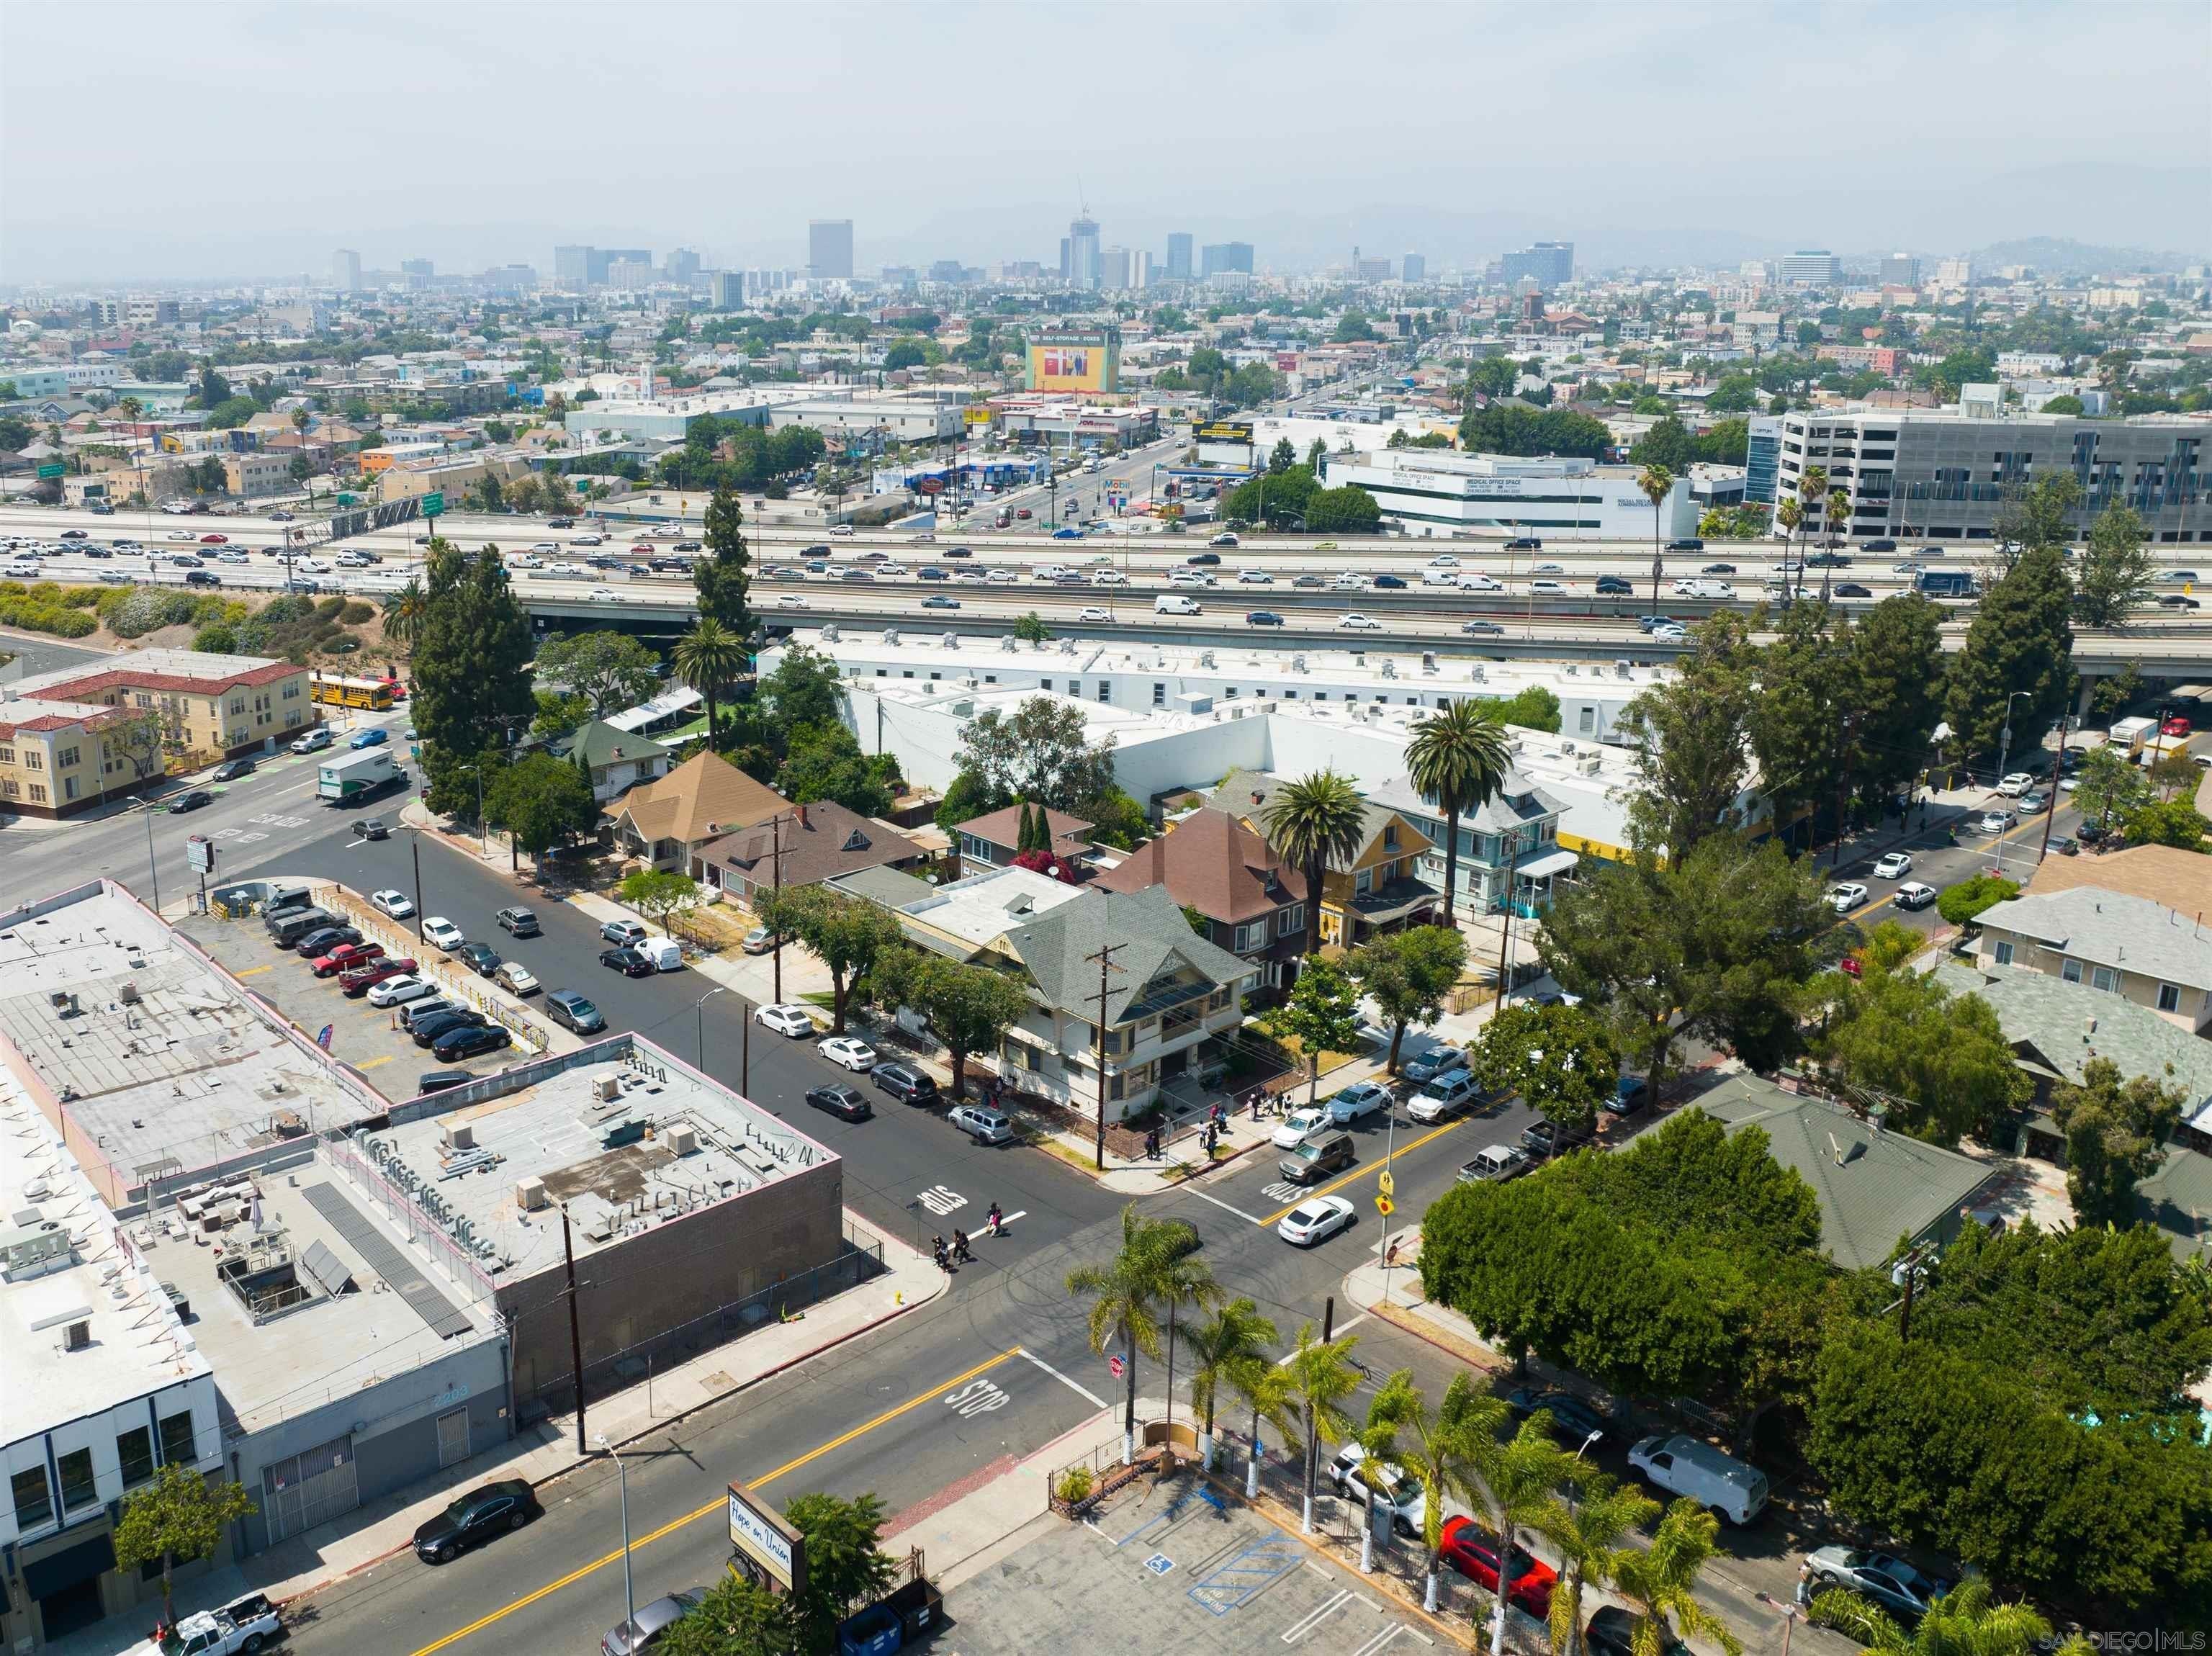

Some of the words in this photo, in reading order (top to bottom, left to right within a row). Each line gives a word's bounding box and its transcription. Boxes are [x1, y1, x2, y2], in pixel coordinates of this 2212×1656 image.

[1105, 480, 1130, 489] Mobil
[916, 1184, 968, 1216] STOP
[1261, 1181, 1315, 1204] STOP
[1110, 1359, 1123, 1372] STOP
[944, 1379, 1010, 1419] STOP
[731, 1500, 751, 1530] Hope
[752, 1527, 763, 1542] on
[764, 1528, 791, 1565] Union
